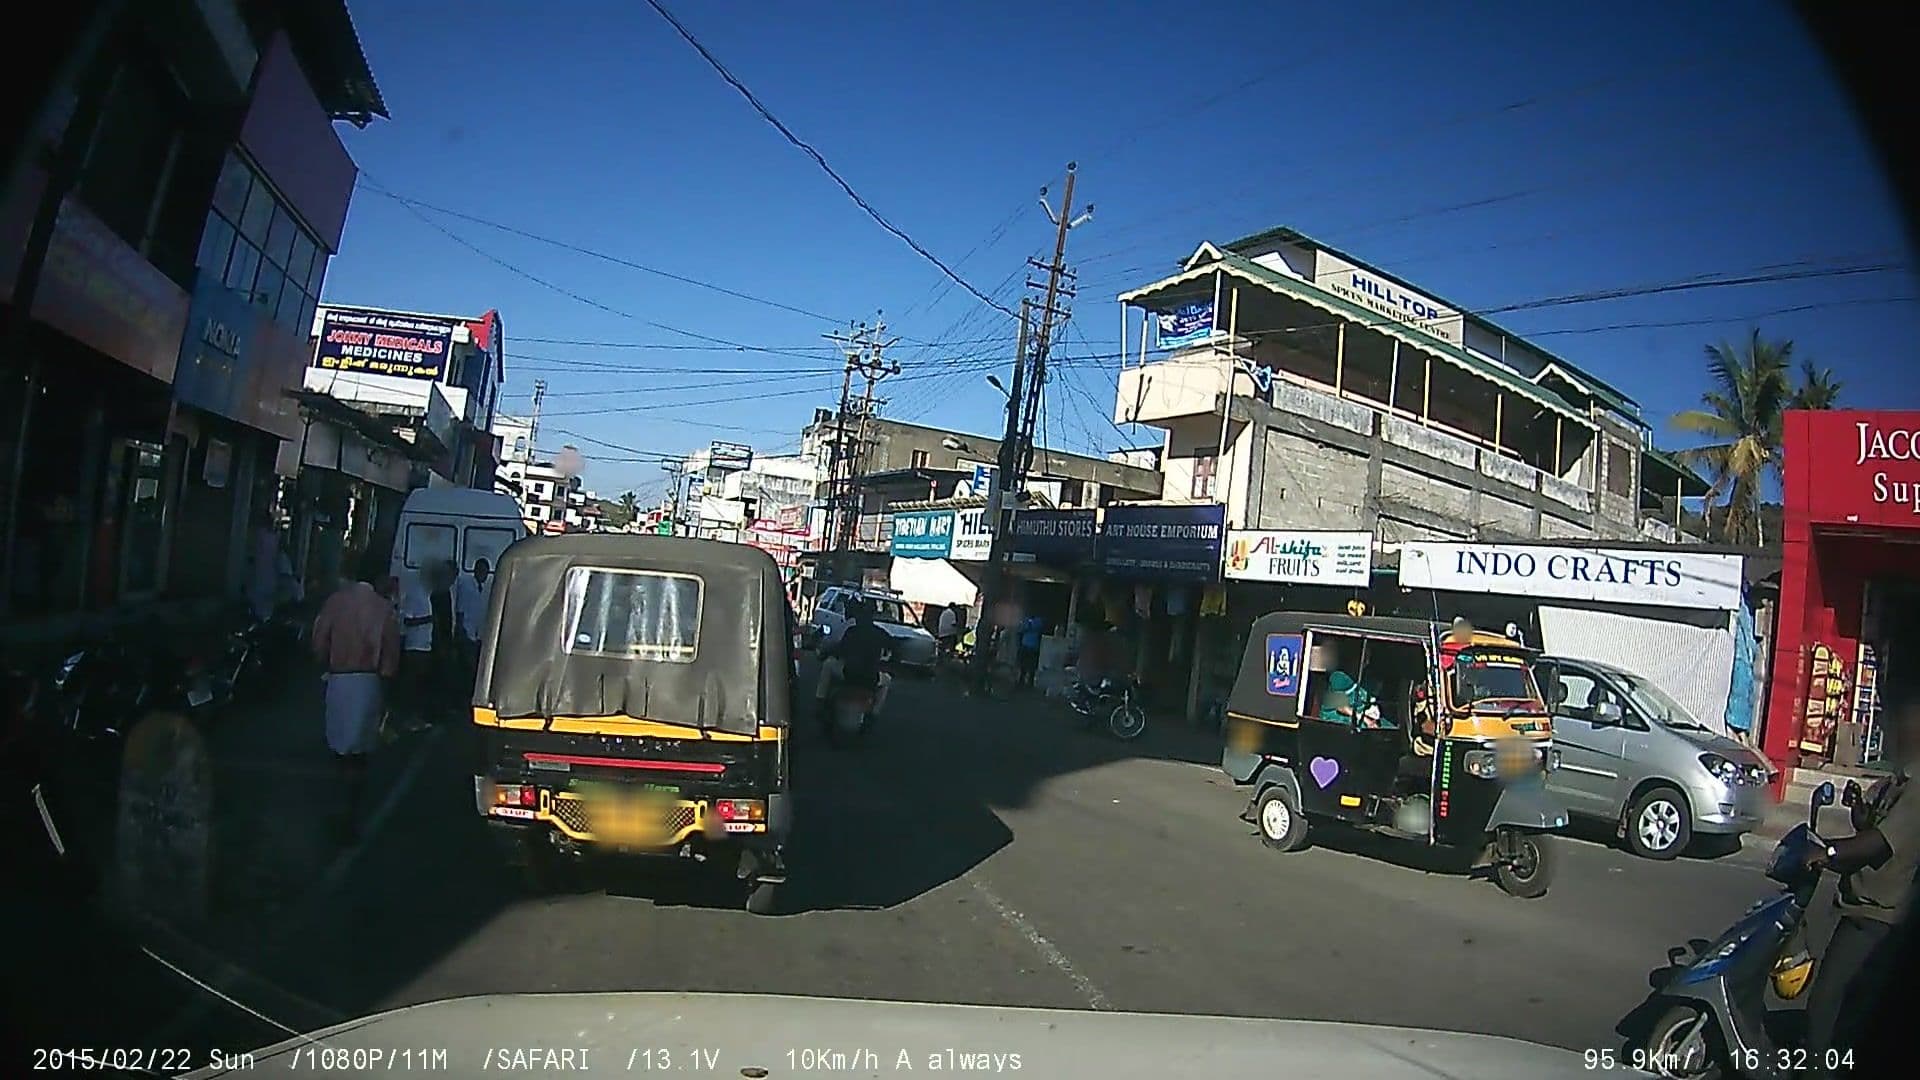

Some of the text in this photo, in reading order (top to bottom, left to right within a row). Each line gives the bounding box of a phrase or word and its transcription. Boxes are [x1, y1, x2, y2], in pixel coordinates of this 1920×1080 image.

[1330, 283, 1363, 303] SPICES
[1366, 299, 1418, 326] MARKETING
[1352, 273, 1438, 320] HILLTOP
[326, 329, 443, 354] JOHNY MEDICALS
[341, 345, 423, 363] MEDICINES
[929, 515, 952, 537] MART
[960, 512, 992, 535] HIL
[1058, 519, 1093, 537] STORES
[1106, 524, 1218, 539] ART HOUSE EMPORIUM
[1269, 557, 1320, 577] FRUITS
[1456, 550, 1682, 587] INDO CRAFTS
